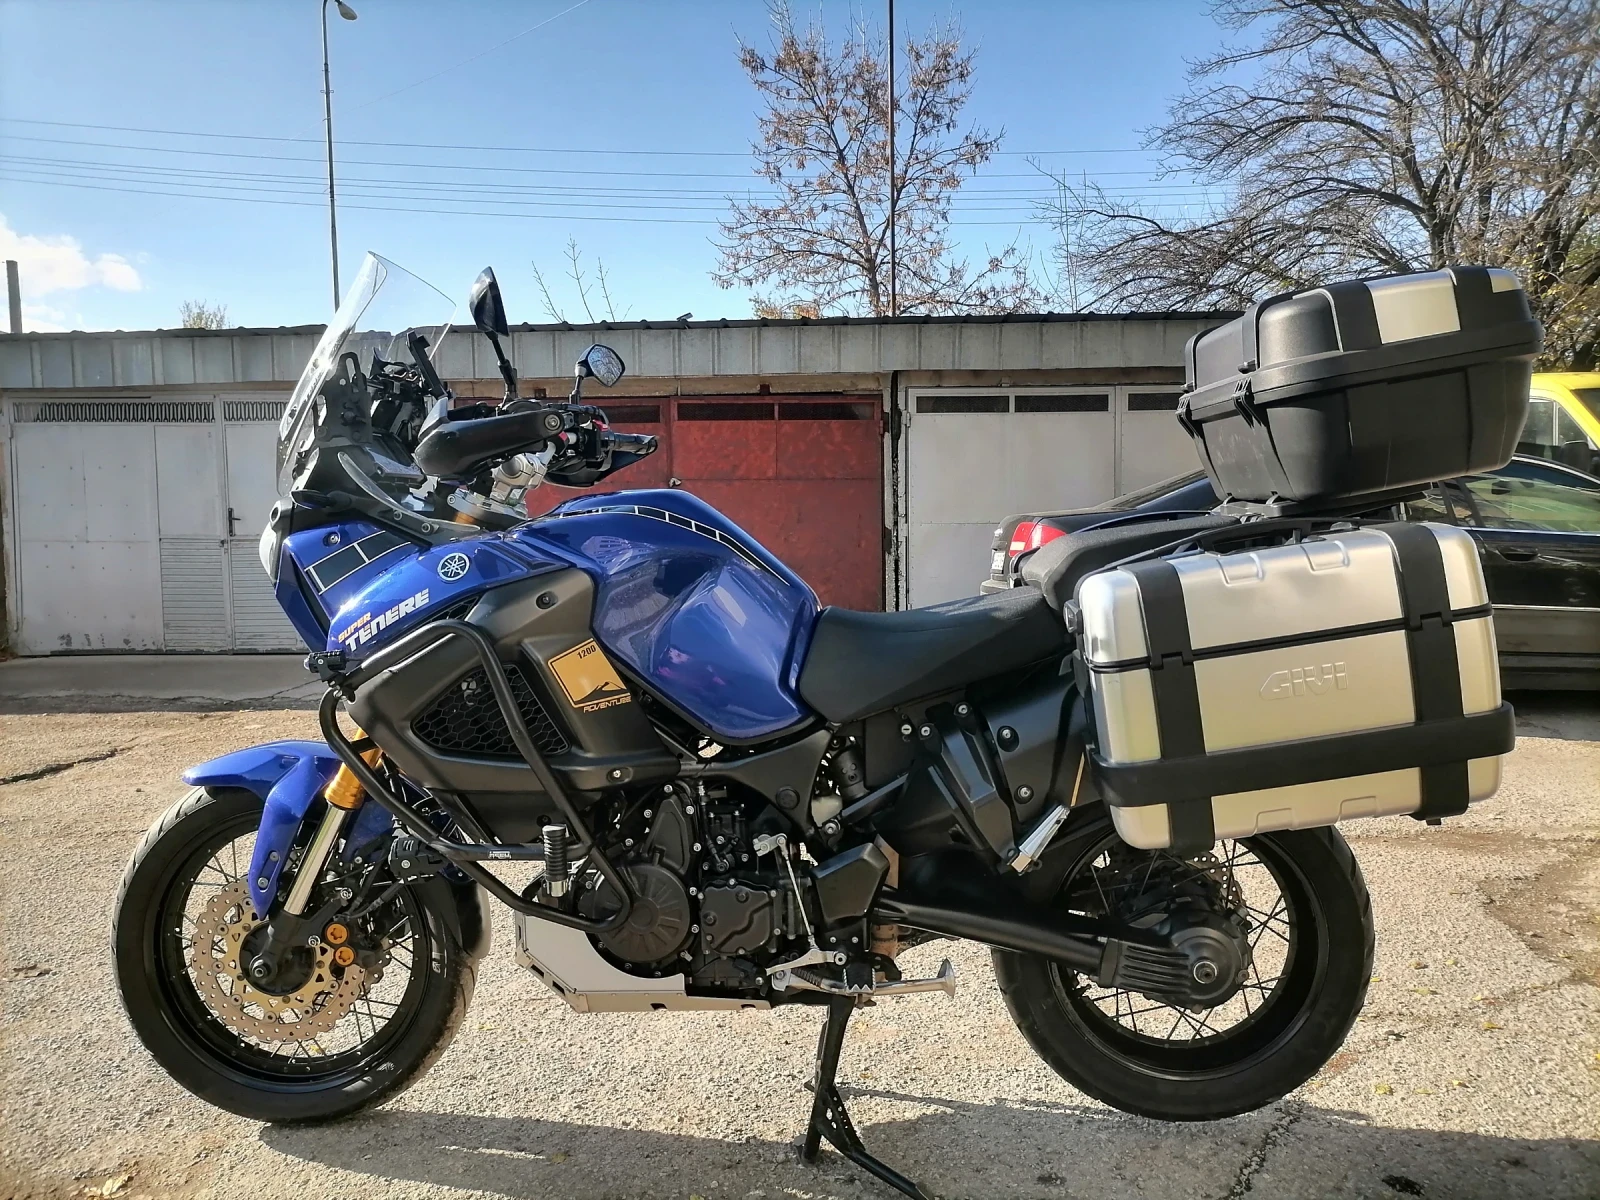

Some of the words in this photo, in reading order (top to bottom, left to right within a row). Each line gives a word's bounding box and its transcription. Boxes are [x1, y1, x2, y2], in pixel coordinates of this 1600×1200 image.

[338, 612, 371, 643] SUPER
[577, 644, 597, 660] 1200
[1259, 661, 1348, 701] GIVI
[583, 695, 632, 713] ADVENTURE
